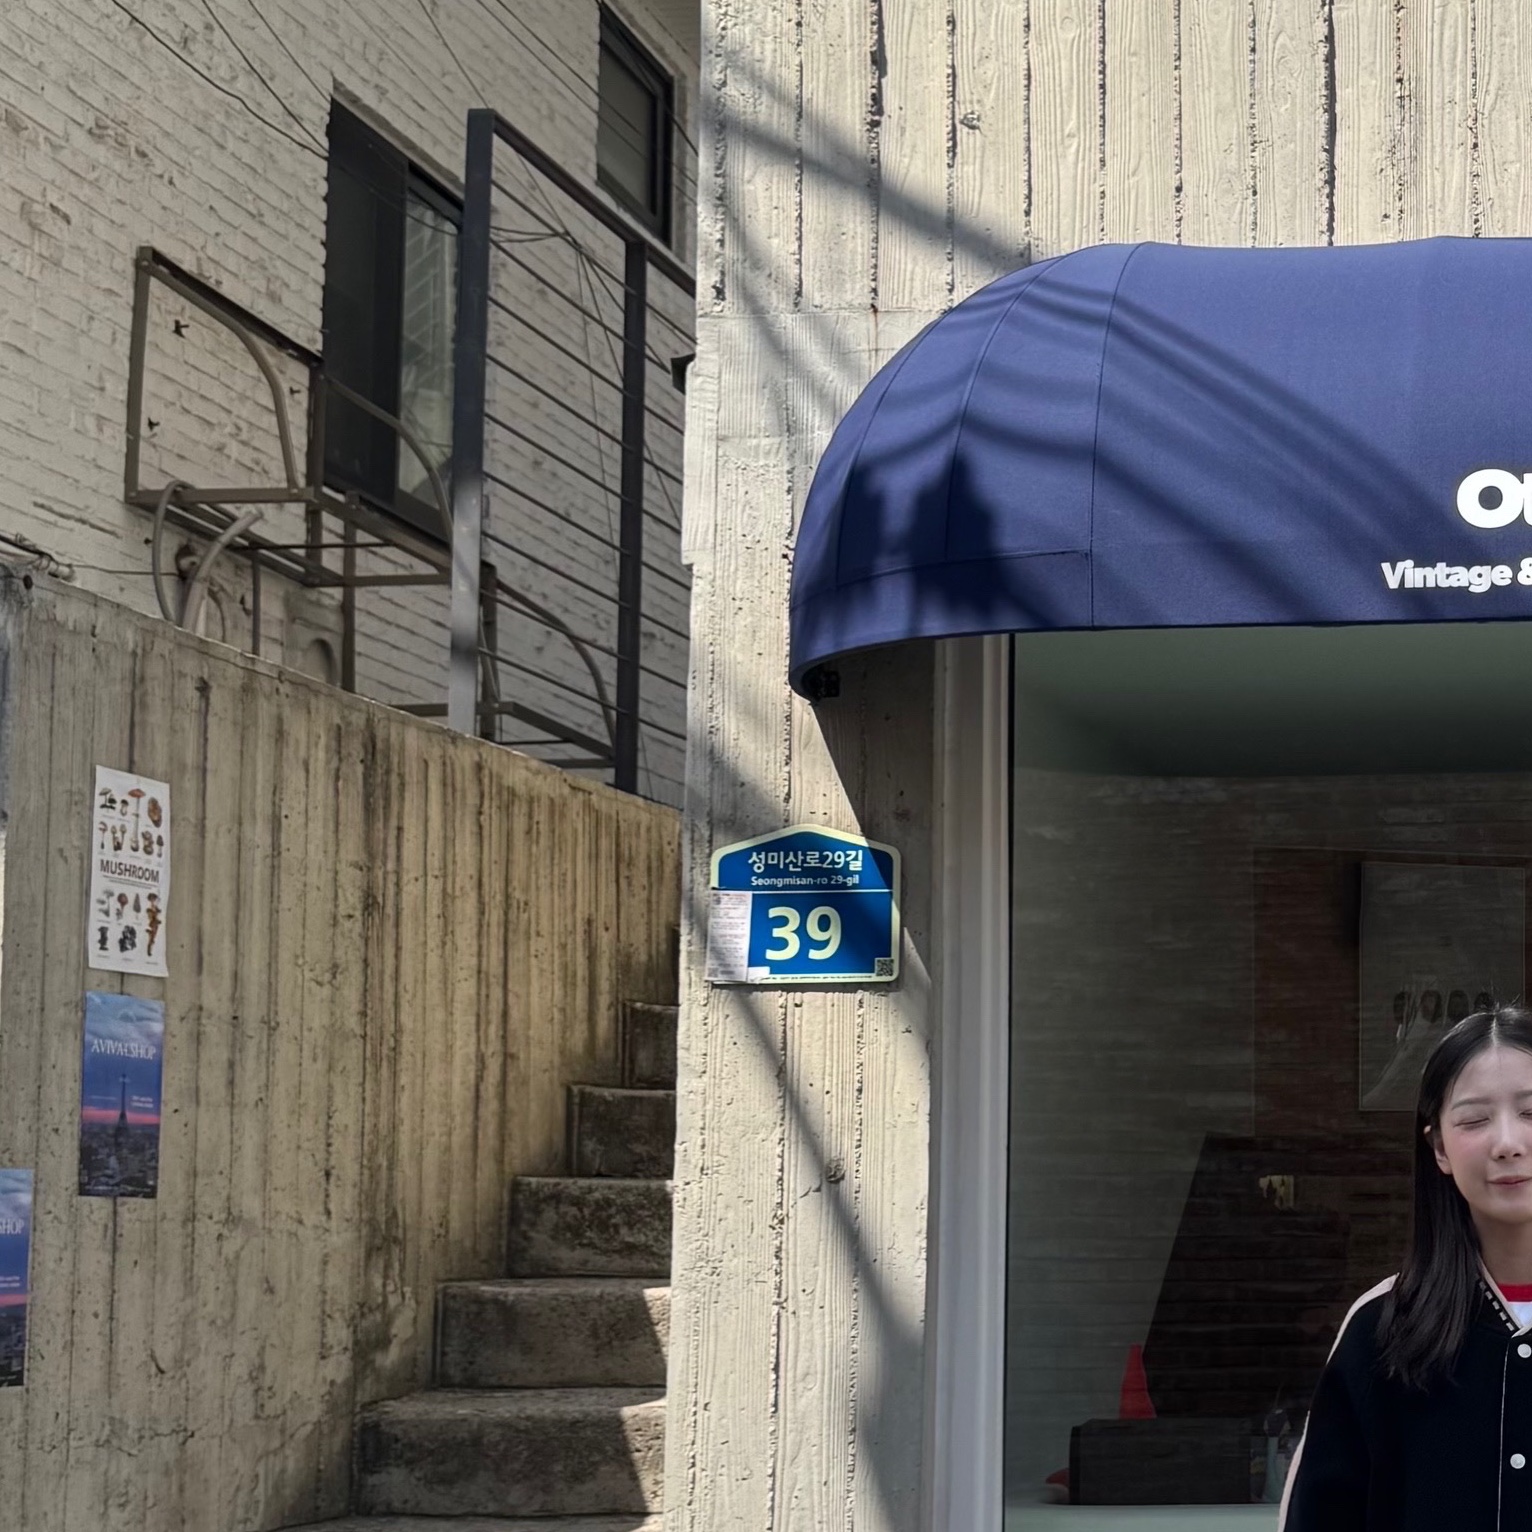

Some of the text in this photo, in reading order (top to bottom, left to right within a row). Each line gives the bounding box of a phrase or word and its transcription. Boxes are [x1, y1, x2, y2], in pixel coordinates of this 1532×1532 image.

[1381, 559, 1513, 593] Vintage
[100, 859, 159, 883] MUSHROOM
[748, 850, 863, 873] 성미산로29길
[751, 874, 860, 887] Seongmisan-ro 29-gil
[765, 906, 842, 961] 39
